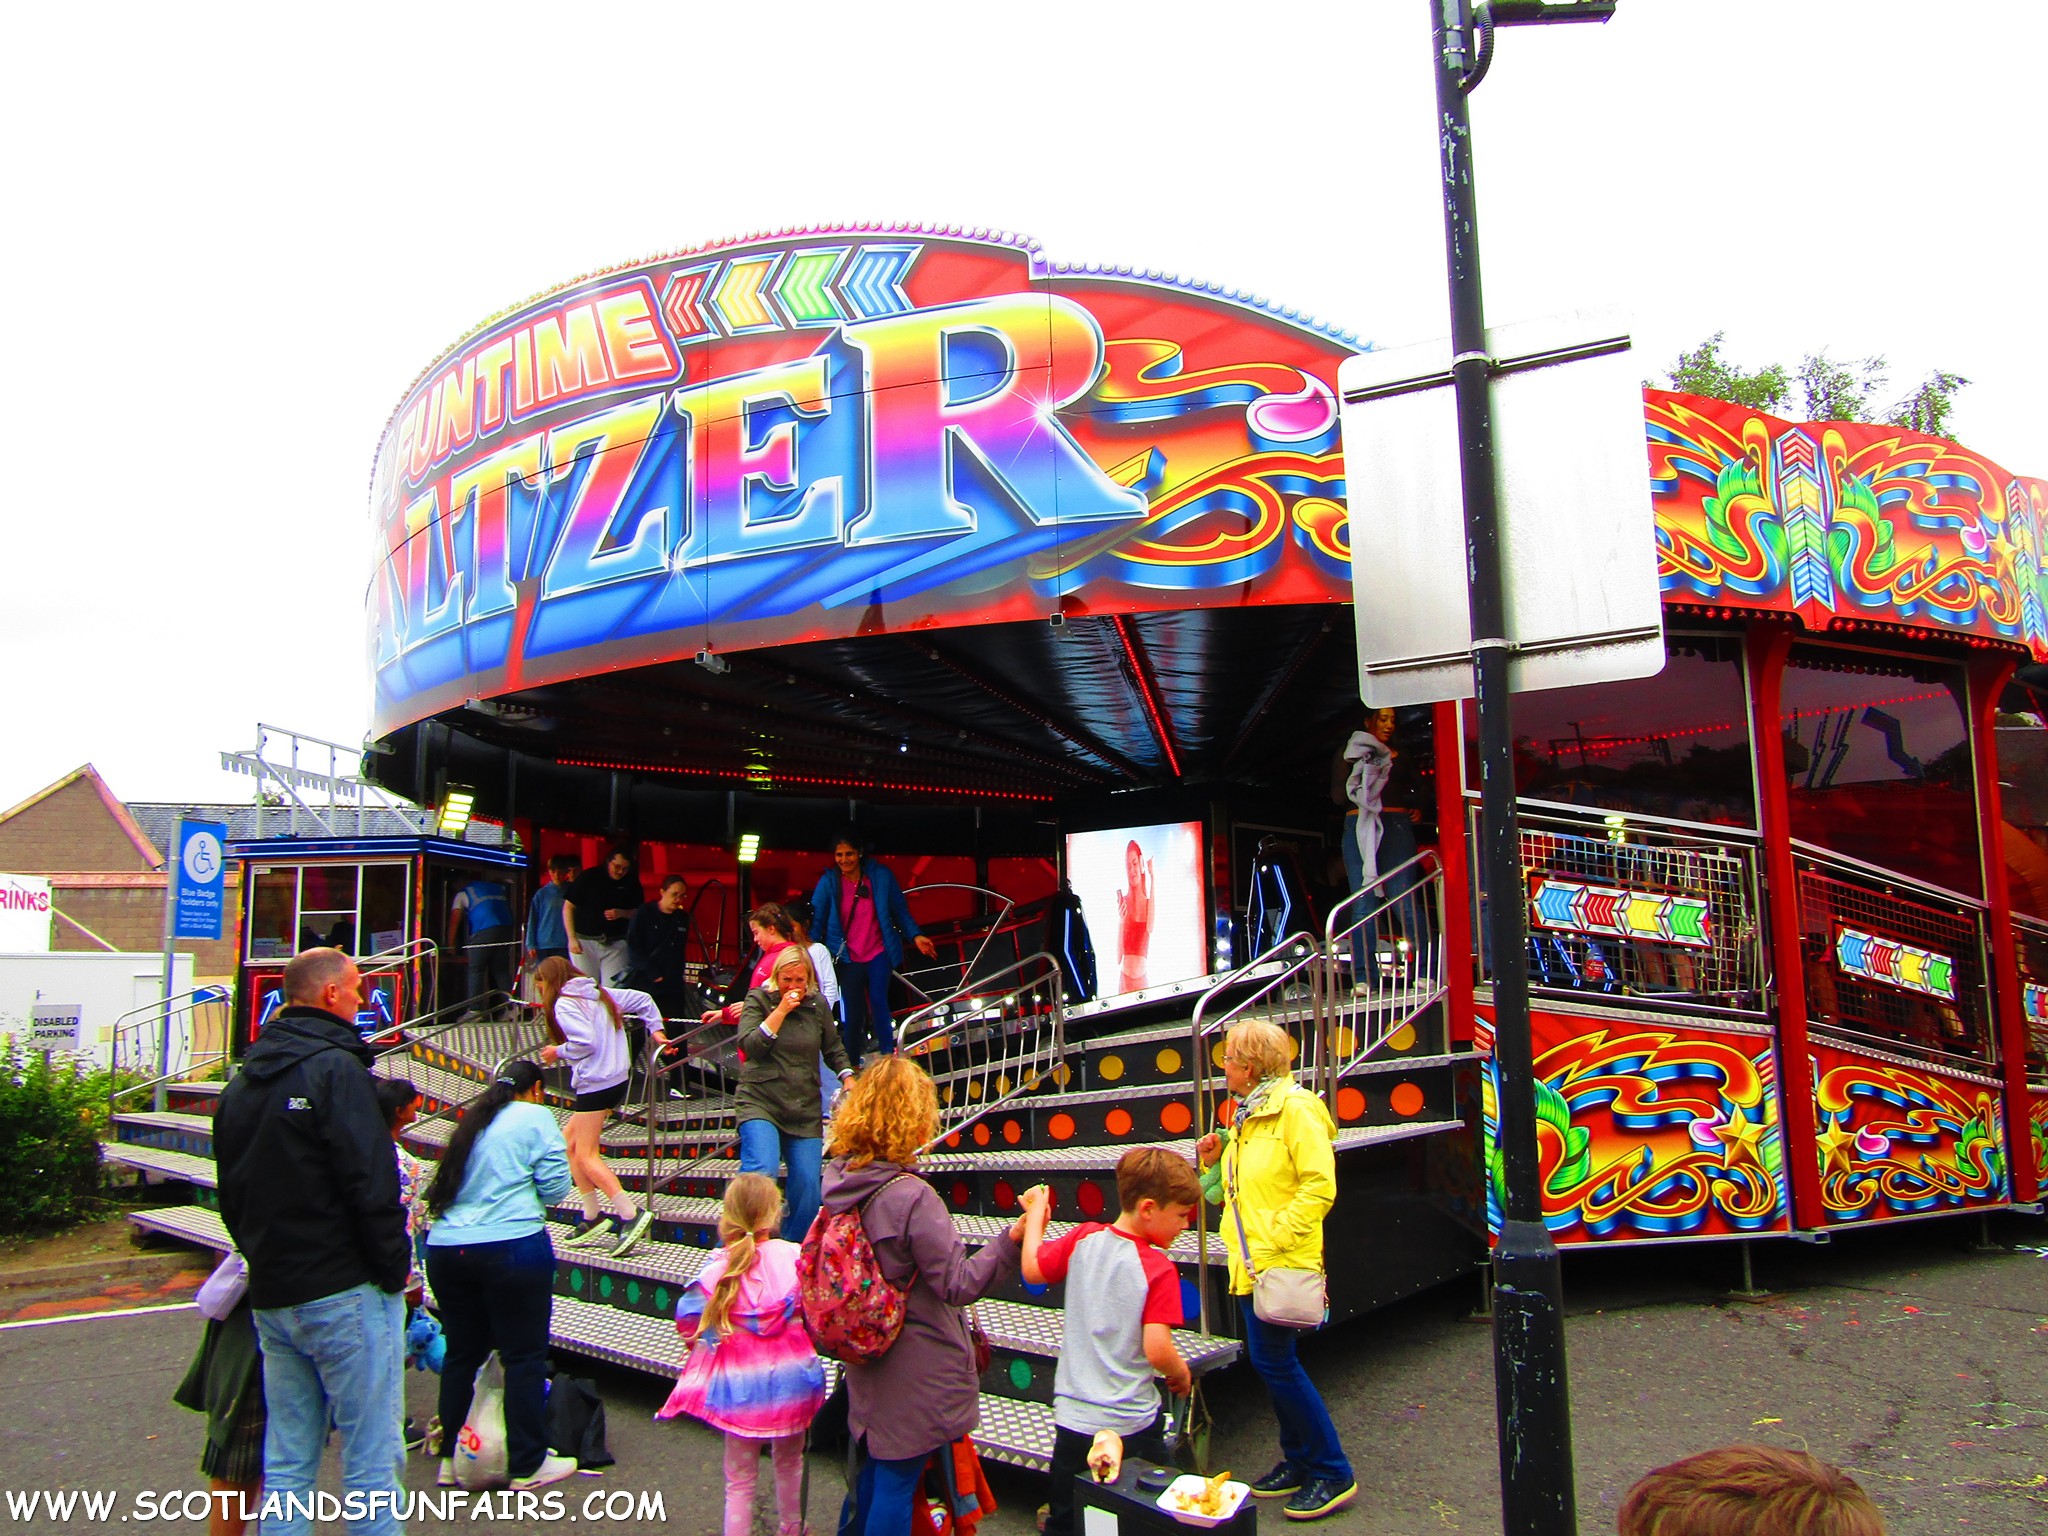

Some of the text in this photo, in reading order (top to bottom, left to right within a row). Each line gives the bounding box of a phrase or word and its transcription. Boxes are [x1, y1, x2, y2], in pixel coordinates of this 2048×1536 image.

[387, 297, 677, 508] FUNTIME
[181, 888, 216, 899] Blue Badge
[181, 898, 205, 907] holders
[33, 1017, 79, 1027] DISABLED
[35, 1029, 75, 1038] PARKING
